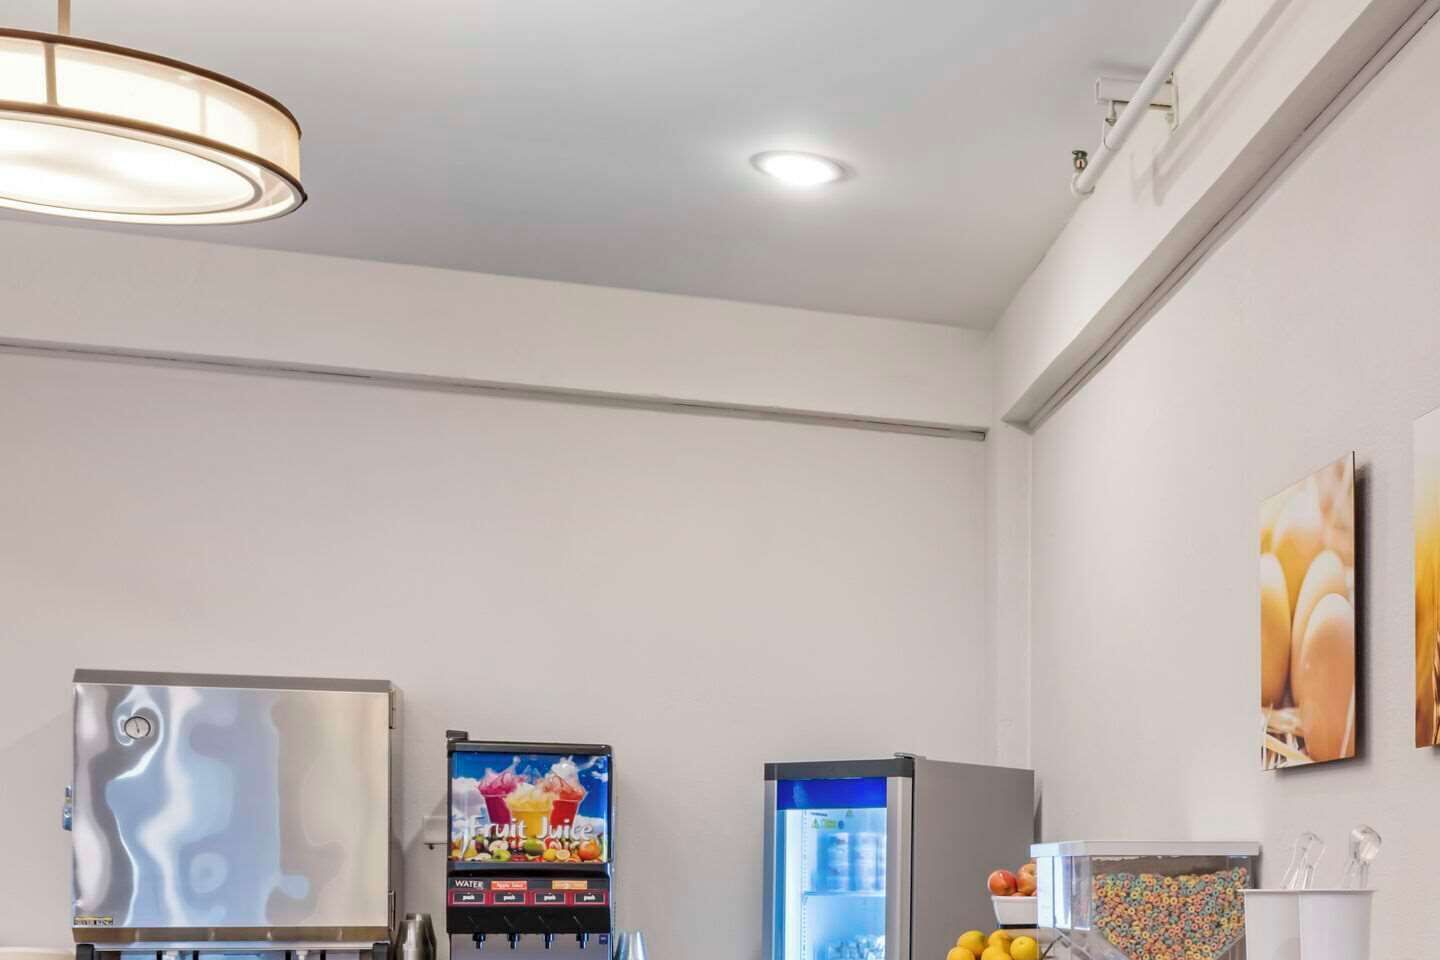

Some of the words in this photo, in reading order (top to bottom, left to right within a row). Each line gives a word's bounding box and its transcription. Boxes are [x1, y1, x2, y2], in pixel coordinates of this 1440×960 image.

[470, 815, 528, 840] Fruit
[536, 816, 593, 840] Juice
[455, 879, 485, 889] WATER
